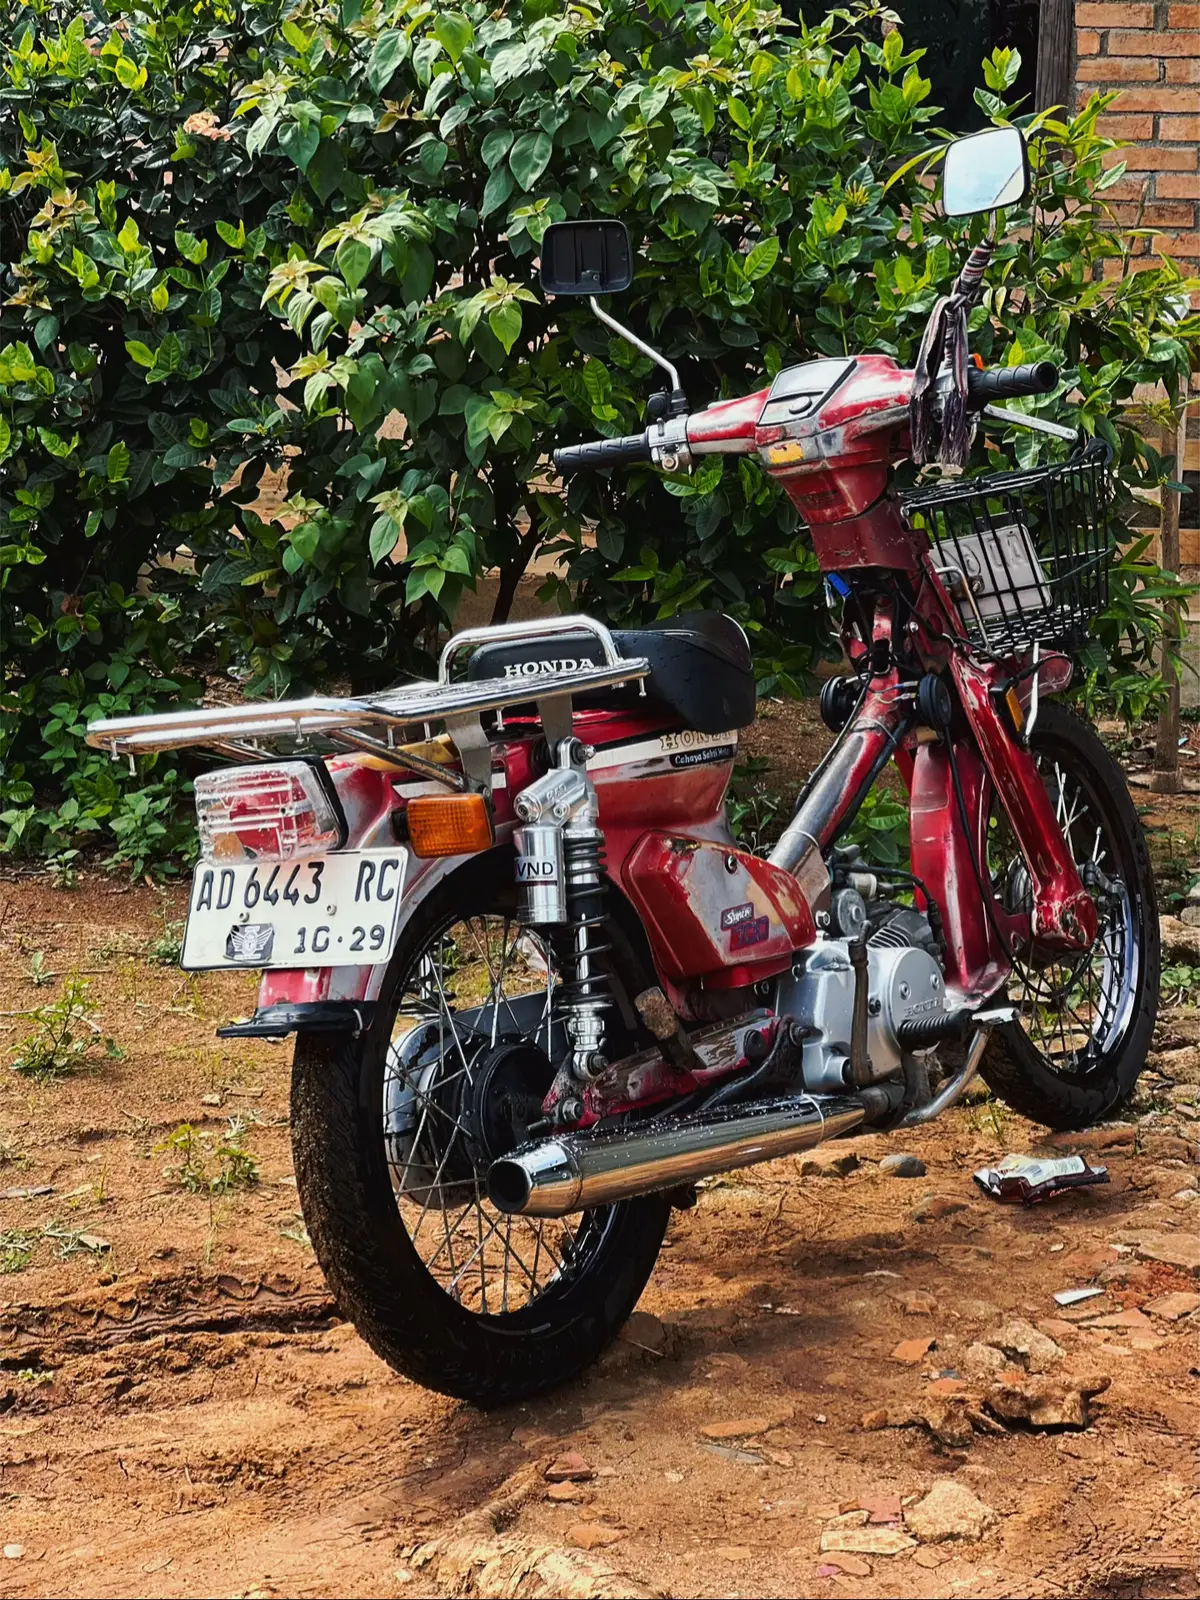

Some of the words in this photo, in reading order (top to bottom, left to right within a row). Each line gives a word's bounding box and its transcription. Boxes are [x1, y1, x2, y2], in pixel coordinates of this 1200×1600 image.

[503, 658, 595, 678] HONDA
[196, 868, 235, 911] AD
[243, 861, 326, 908] 6443
[354, 858, 399, 902] RC
